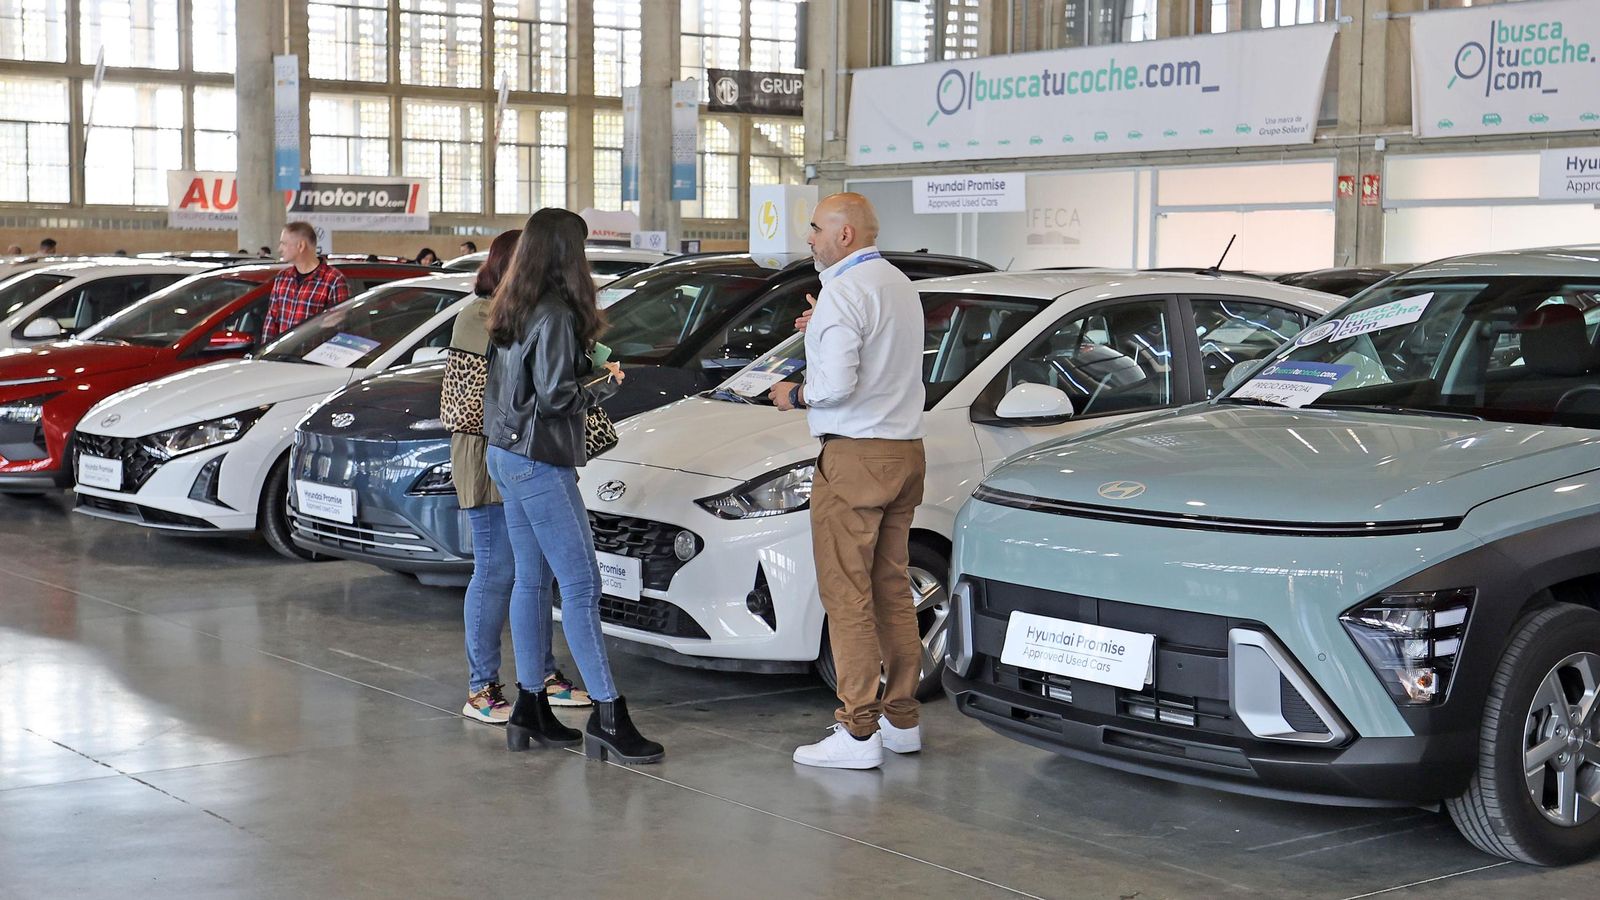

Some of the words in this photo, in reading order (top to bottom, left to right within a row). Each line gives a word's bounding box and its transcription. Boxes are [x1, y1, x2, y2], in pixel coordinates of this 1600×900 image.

[1497, 19, 1563, 43] busca
[1496, 37, 1596, 68] tucoche.
[716, 78, 738, 104] MG
[760, 77, 804, 95] GRUP
[1566, 156, 1600, 173] Hyu
[179, 177, 240, 212] AU
[926, 179, 966, 195] Hyundai
[967, 177, 1006, 191] Promise
[299, 186, 406, 208] motor10.com
[928, 199, 960, 209] Approved
[962, 198, 979, 207] Used
[981, 197, 998, 207] Cars
[1025, 207, 1081, 228] IFECA
[1350, 302, 1402, 320] busca
[599, 561, 626, 576] Promise
[1026, 625, 1076, 647] Hyundai
[1076, 634, 1126, 656] Promise
[1023, 646, 1065, 663] Approved
[1065, 654, 1089, 668] Used
[1090, 659, 1111, 672] Cars
